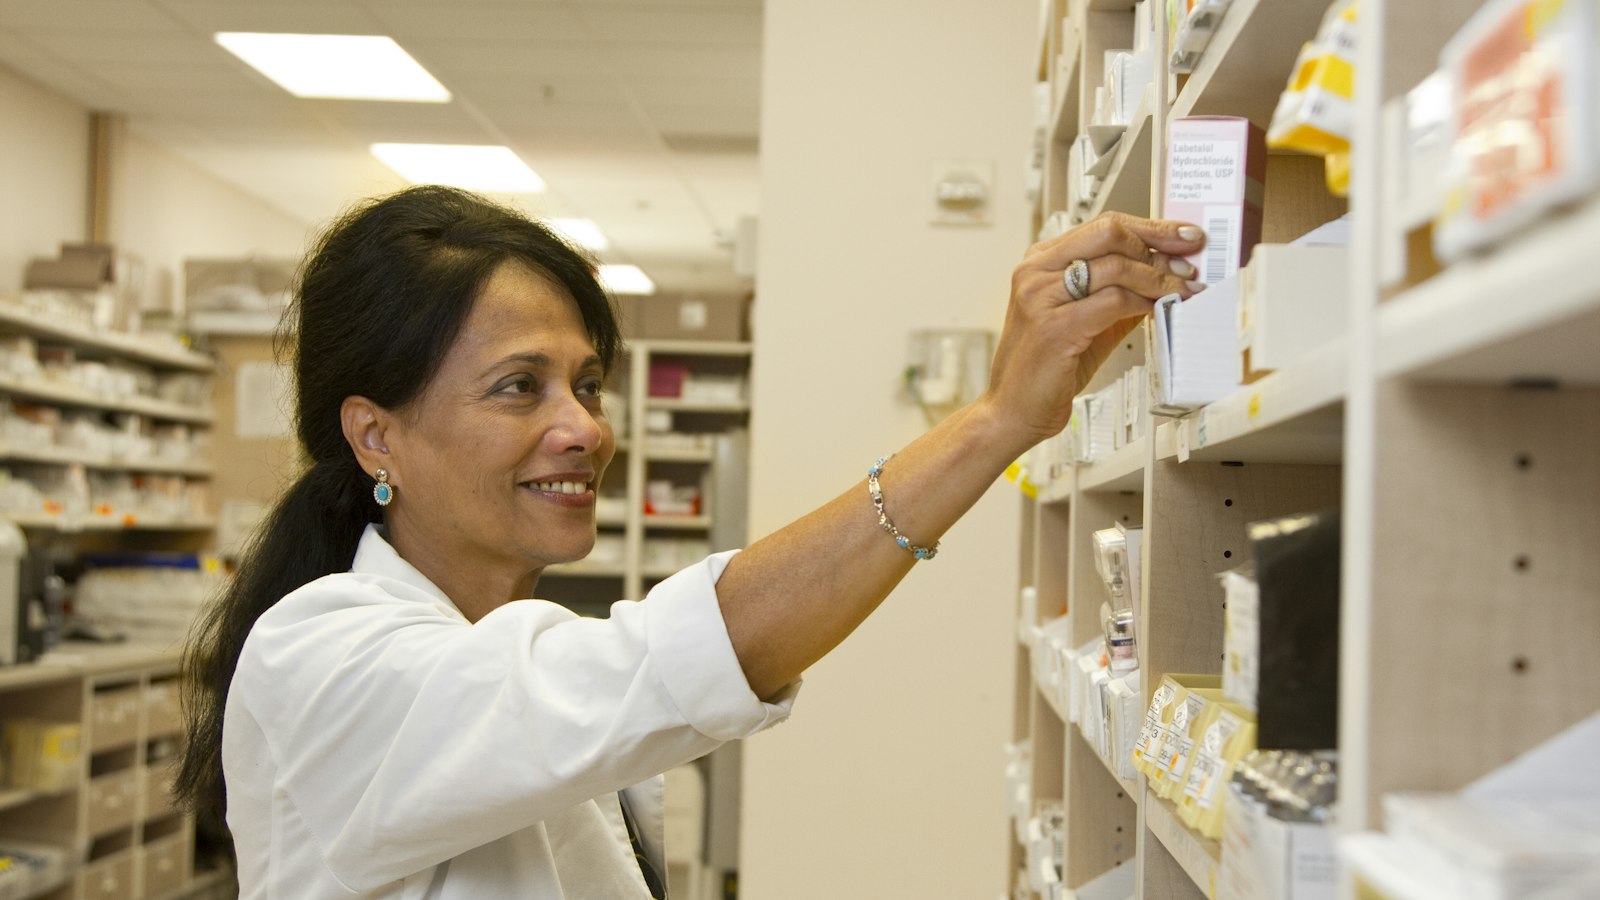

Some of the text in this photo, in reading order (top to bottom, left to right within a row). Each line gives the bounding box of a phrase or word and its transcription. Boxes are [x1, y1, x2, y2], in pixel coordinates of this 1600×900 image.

[1173, 143, 1214, 153] Labetalol
[1173, 156, 1234, 167] Hydrochloride
[1215, 168, 1234, 178] USP
